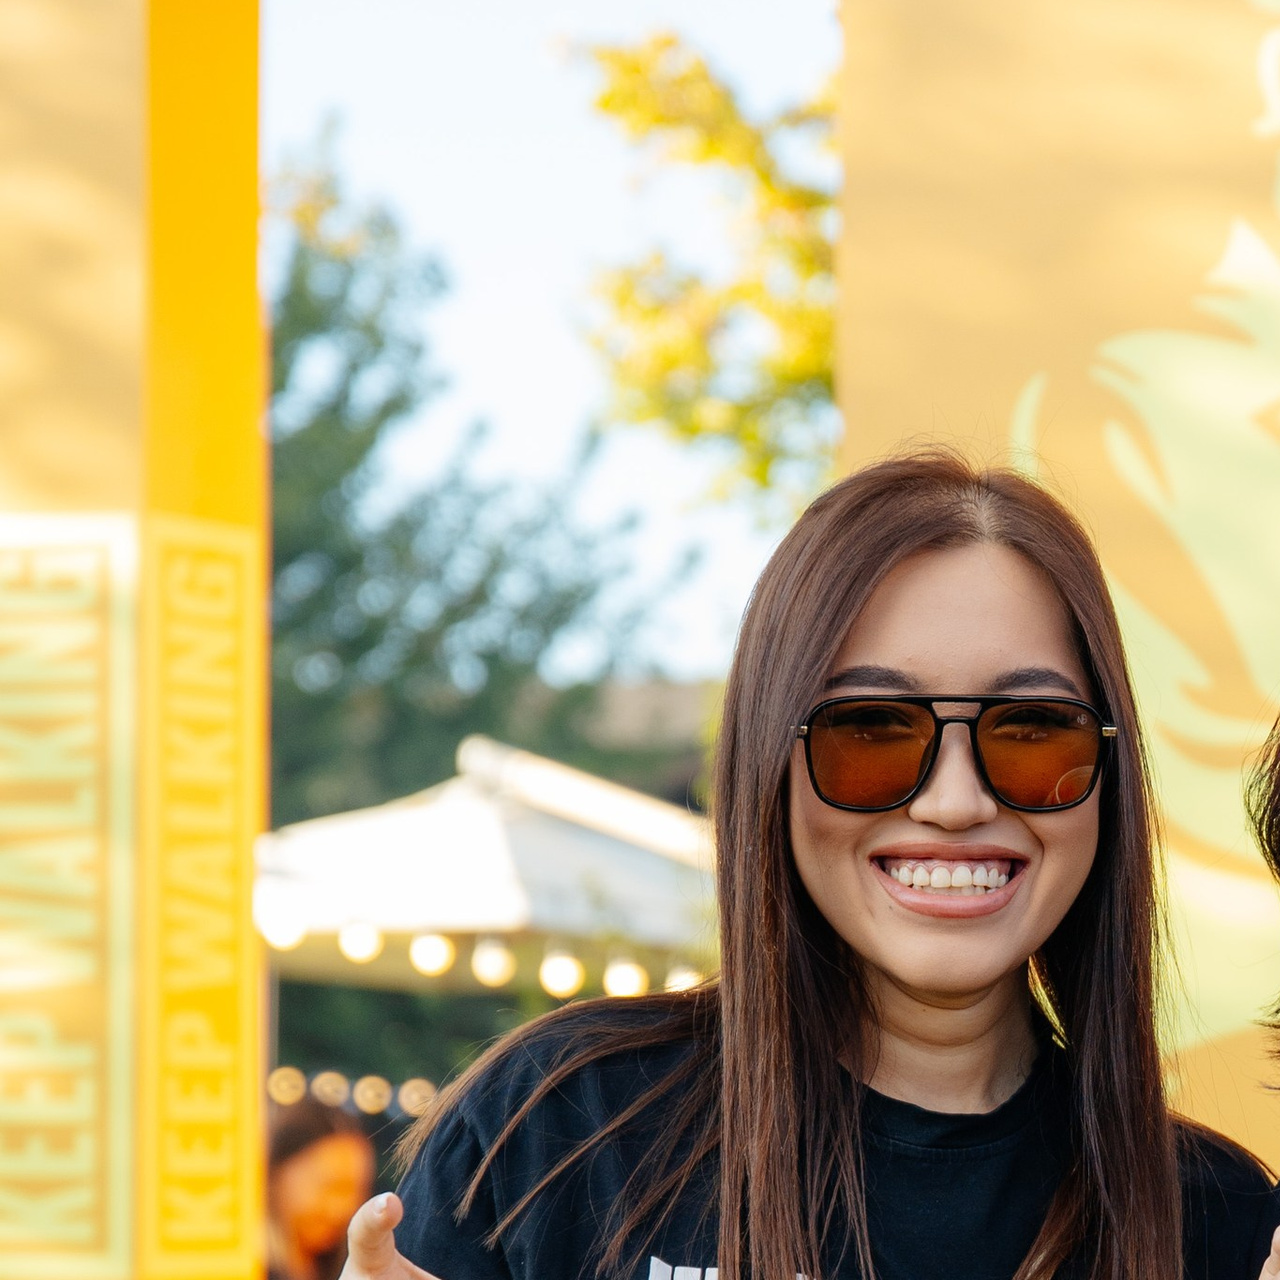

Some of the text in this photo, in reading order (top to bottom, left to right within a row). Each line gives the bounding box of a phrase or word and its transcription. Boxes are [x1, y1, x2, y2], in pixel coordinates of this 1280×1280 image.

[0, 1012, 95, 1240] KEEP
[165, 557, 236, 1240] KEEP WALKING
